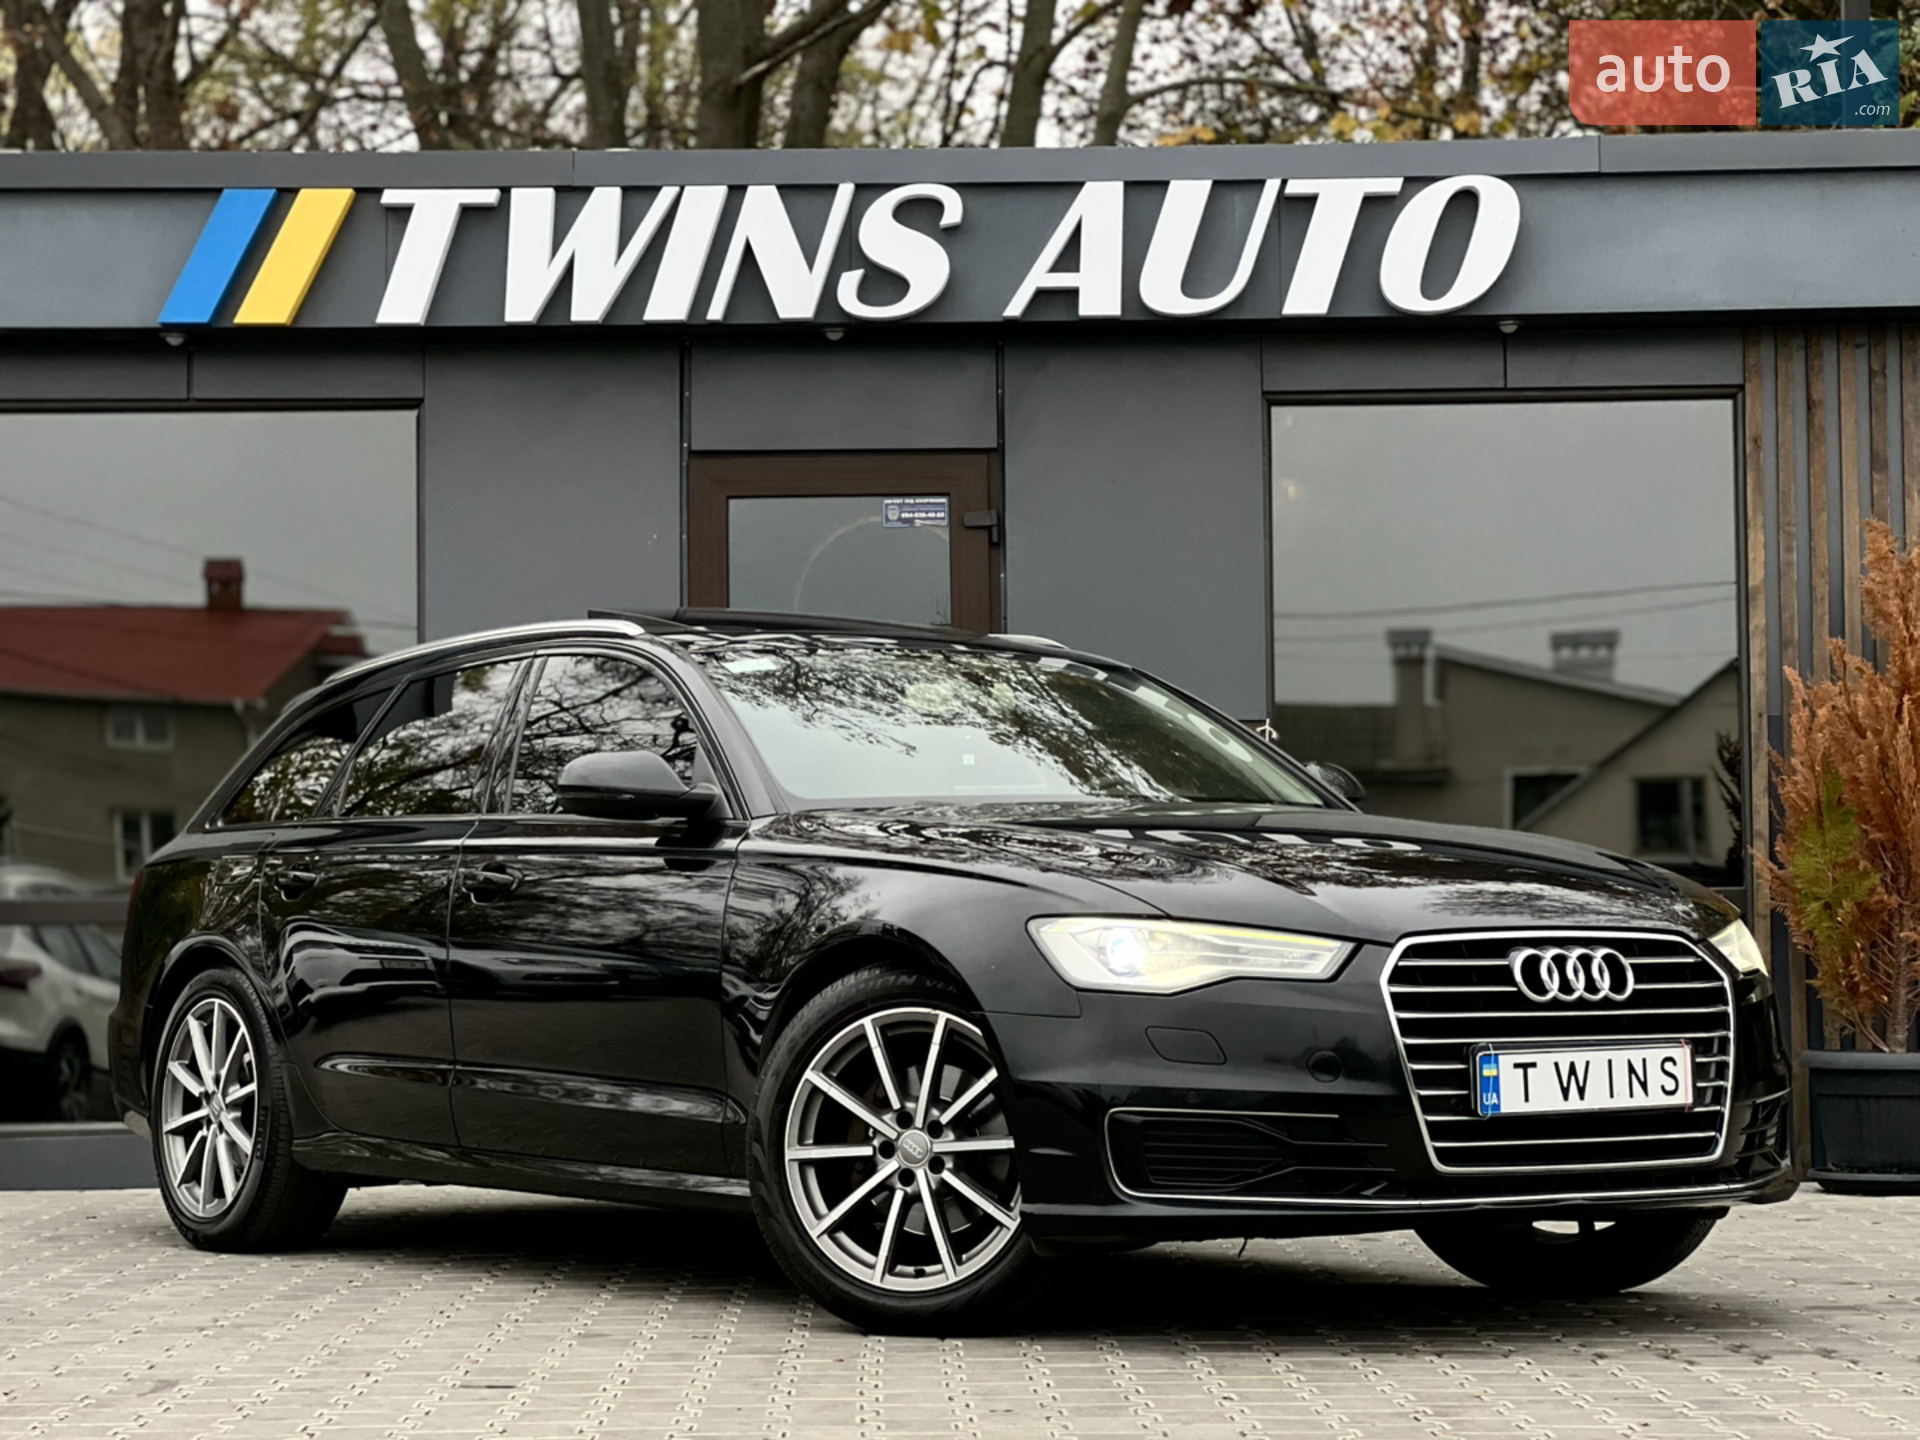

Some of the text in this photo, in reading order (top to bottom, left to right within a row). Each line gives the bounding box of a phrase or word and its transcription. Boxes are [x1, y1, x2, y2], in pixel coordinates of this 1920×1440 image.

[375, 174, 1521, 325] TWINS AUTO
[1482, 1092, 1499, 1106] UA
[1513, 1056, 1680, 1103] TWINS
